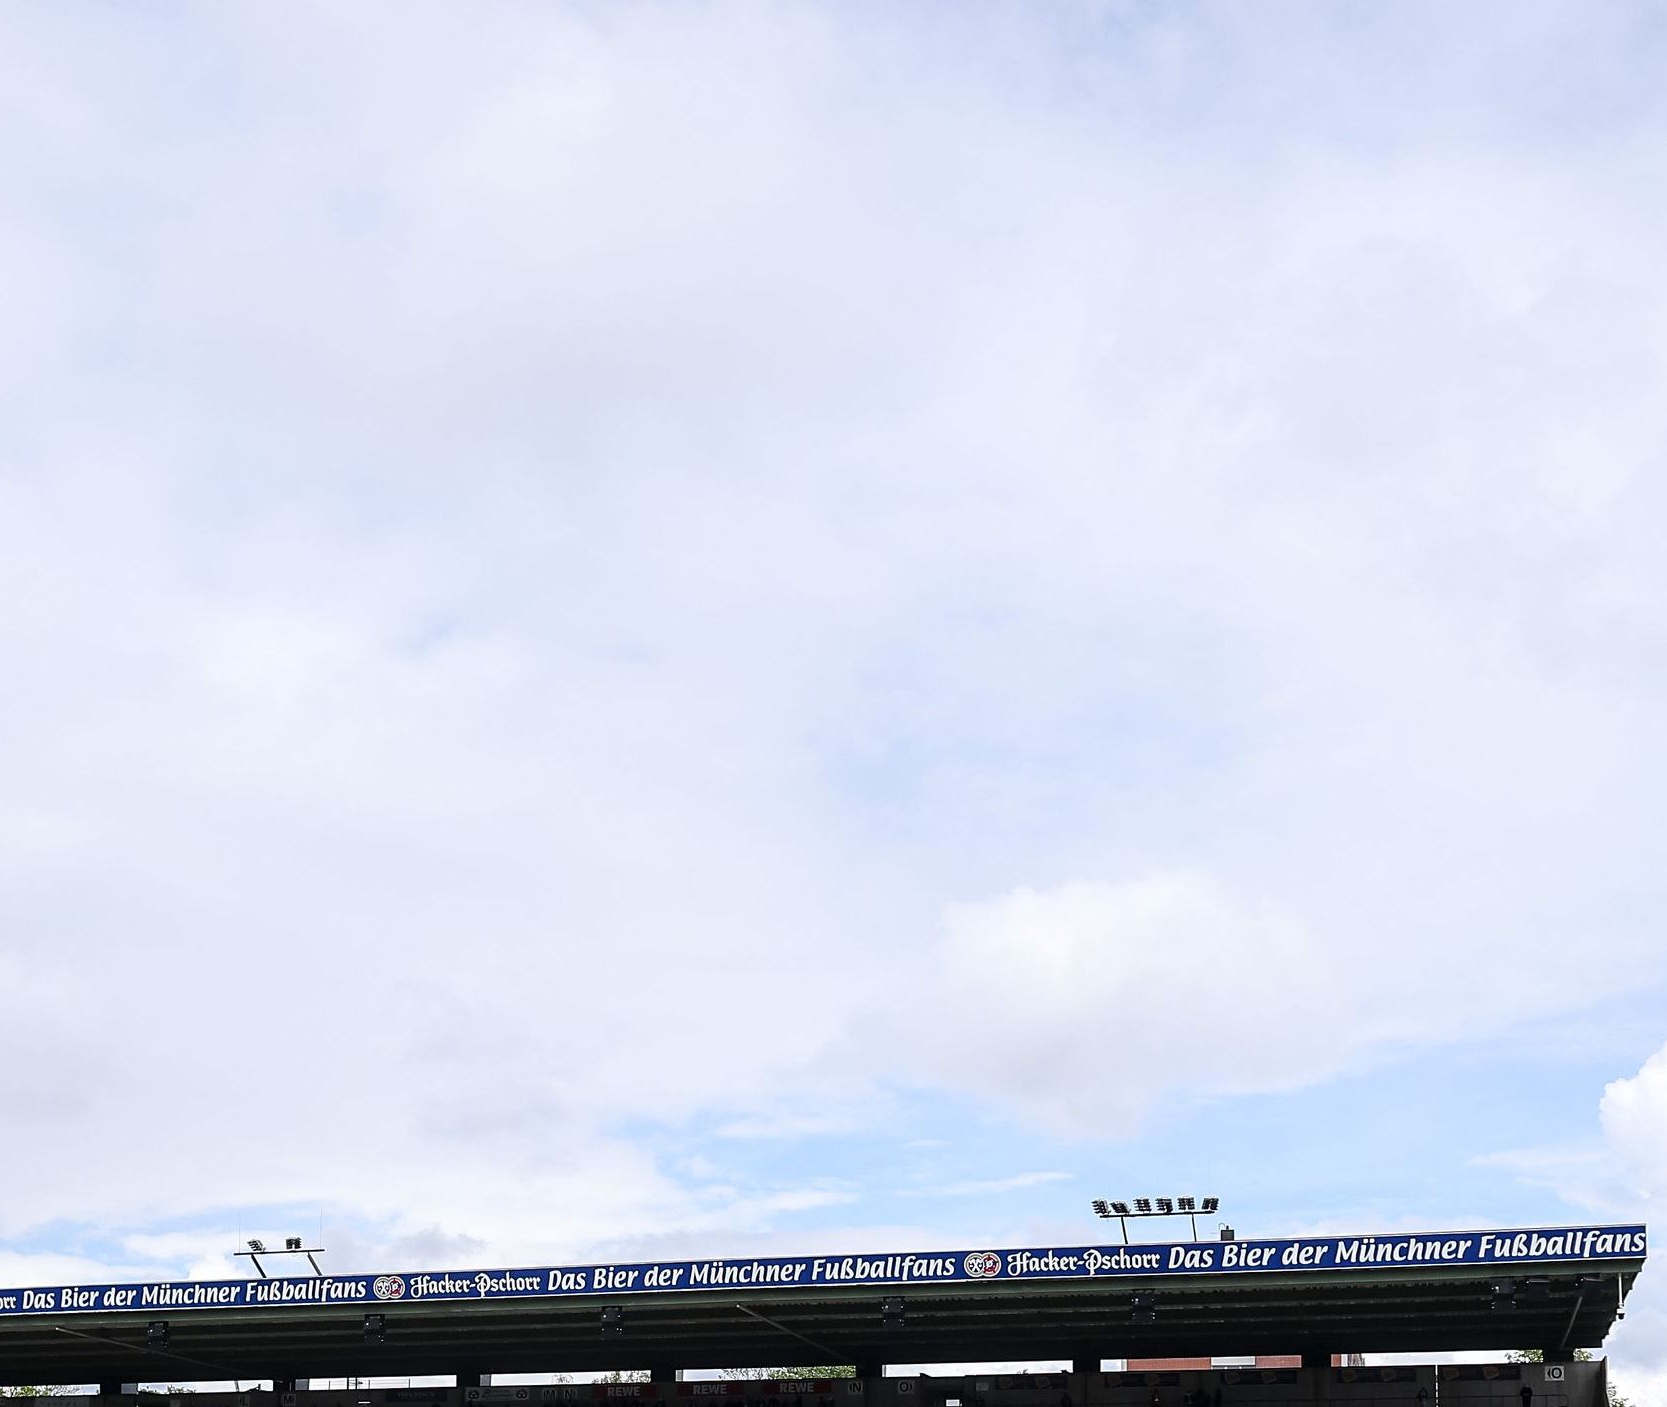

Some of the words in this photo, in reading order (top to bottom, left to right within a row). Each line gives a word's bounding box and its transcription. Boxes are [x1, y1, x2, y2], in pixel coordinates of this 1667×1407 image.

[1007, 1249, 1161, 1276] Hacker-Pschorr
[1169, 1246, 1213, 1269] Das
[1222, 1243, 1276, 1267] Bier
[1282, 1242, 1329, 1266] der
[1334, 1237, 1472, 1264] Münchner
[1478, 1230, 1646, 1259] Fußballfans
[410, 1272, 541, 1299] Hacker-Pschorr
[548, 1270, 586, 1291] Das
[593, 1267, 639, 1289] Bier
[644, 1266, 684, 1287] der
[689, 1262, 805, 1285] Münchner
[811, 1256, 955, 1281] Fußballfans
[22, 1290, 54, 1310] Das
[61, 1288, 99, 1308] Bier
[103, 1286, 137, 1307] der
[141, 1284, 240, 1305] Münchner
[245, 1278, 366, 1302] Fußballfans
[607, 1387, 640, 1397] REWE
[693, 1384, 727, 1395] REWE
[780, 1382, 815, 1393] REWE
